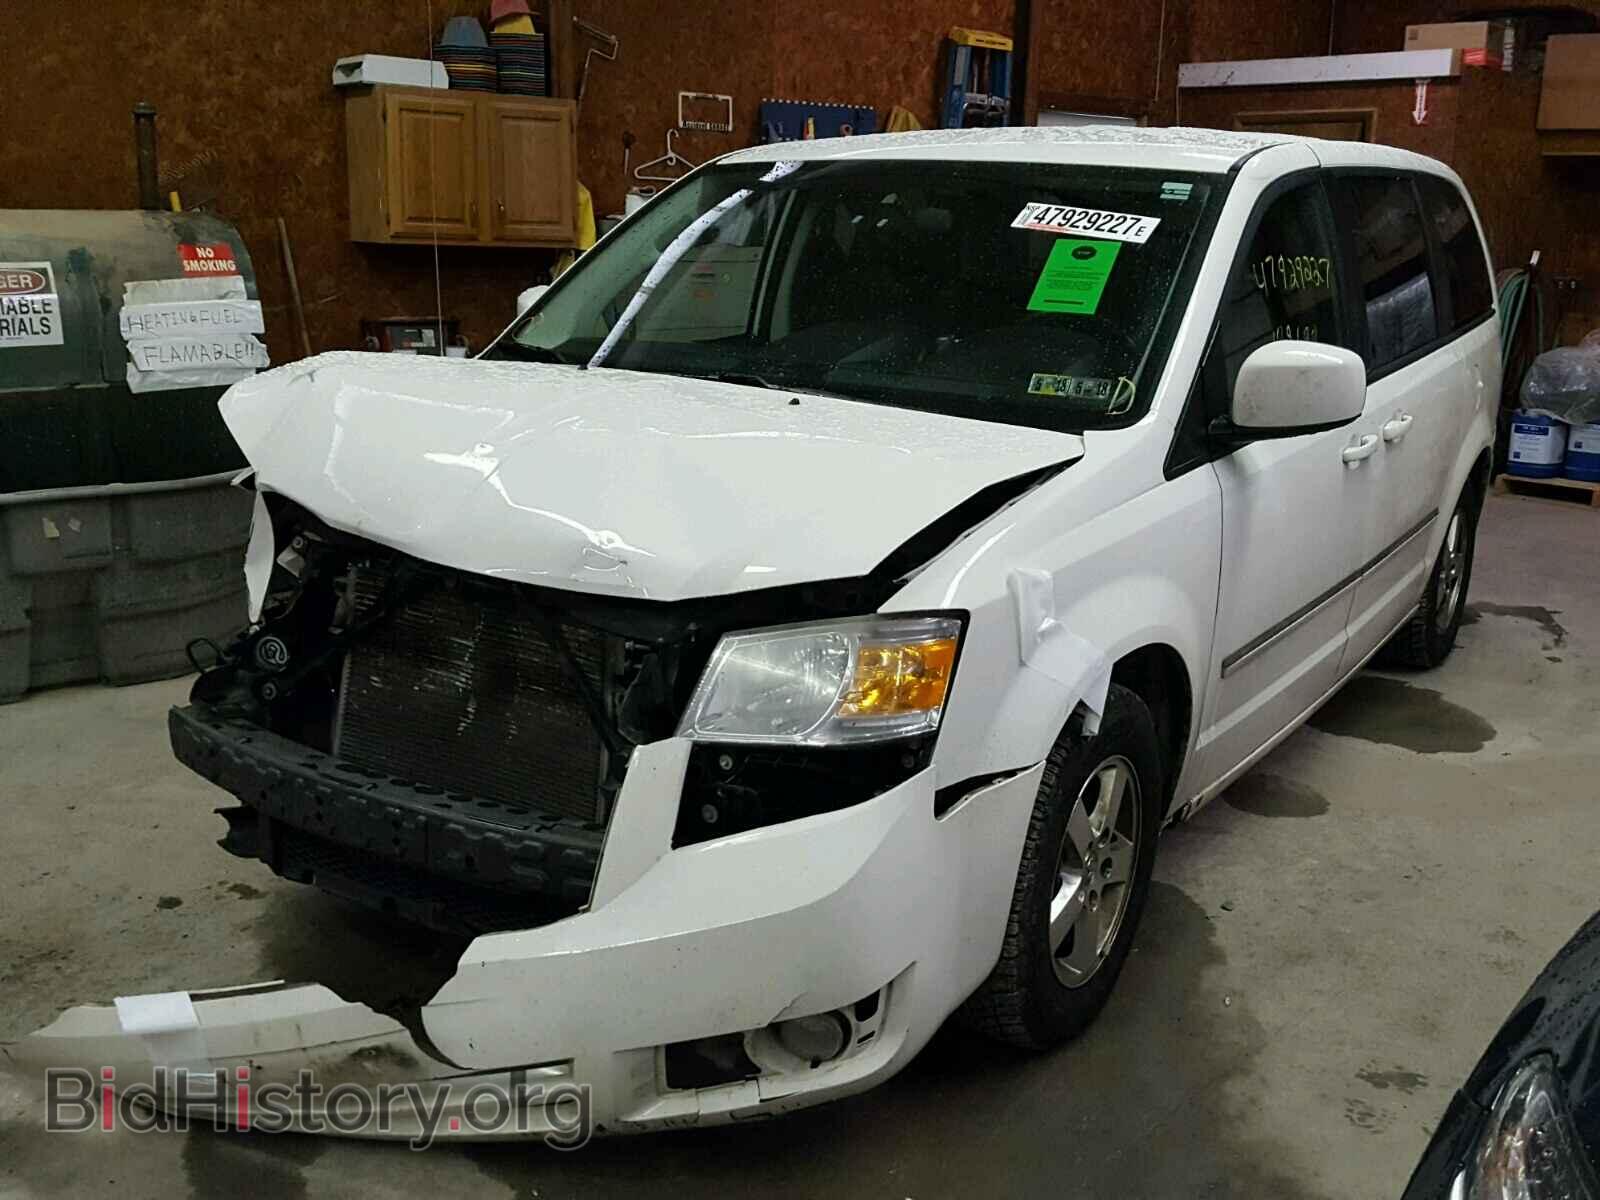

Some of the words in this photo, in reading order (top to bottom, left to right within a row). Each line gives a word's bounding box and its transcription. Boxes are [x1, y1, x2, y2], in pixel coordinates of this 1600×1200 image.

[1033, 206, 1142, 236] 47929227
[195, 247, 215, 259] NO
[182, 259, 237, 272] SMOKING
[0, 316, 52, 337] RIALS
